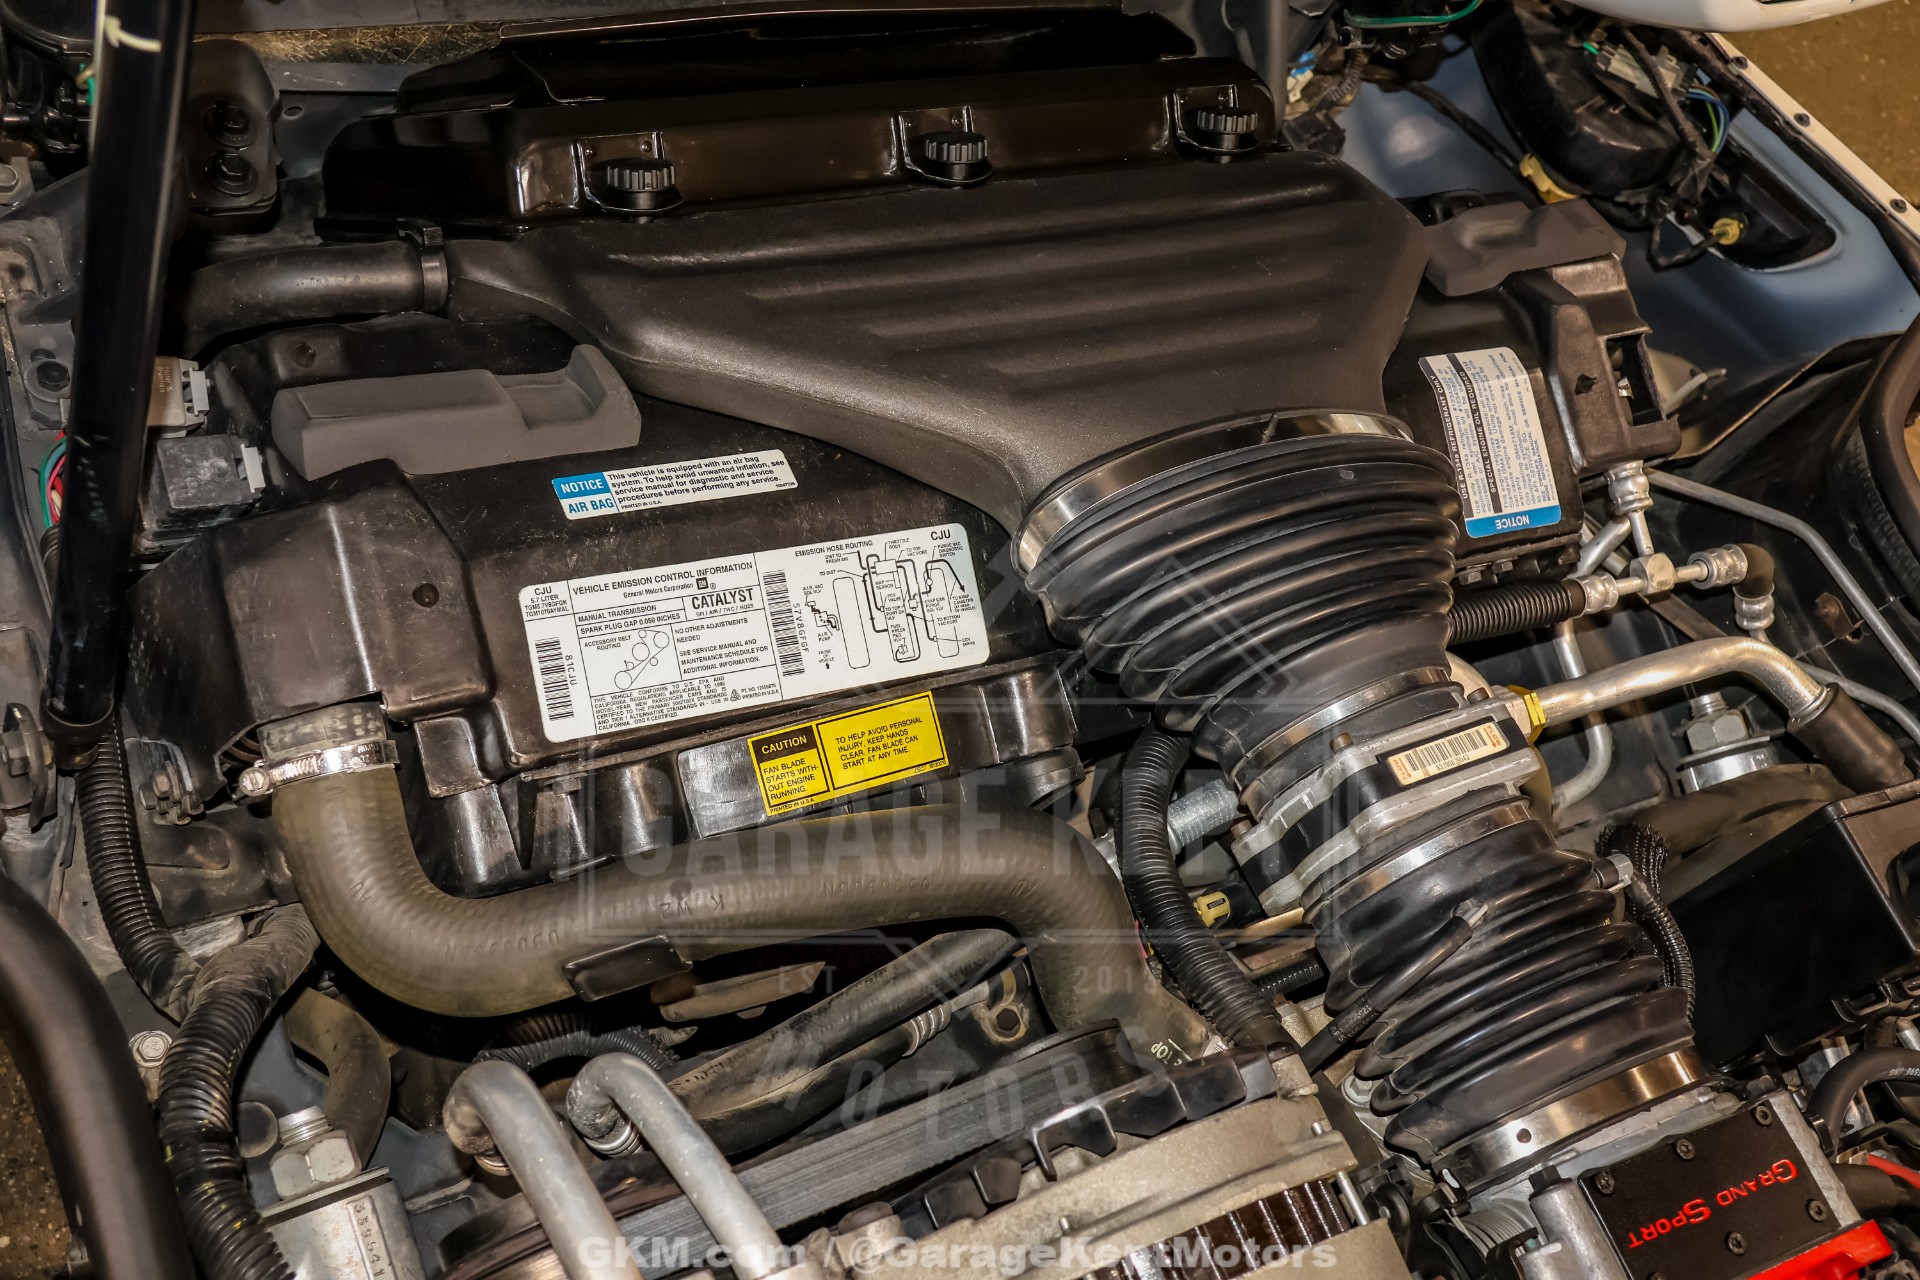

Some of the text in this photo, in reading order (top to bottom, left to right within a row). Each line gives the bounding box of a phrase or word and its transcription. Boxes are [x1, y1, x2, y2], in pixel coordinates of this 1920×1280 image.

[1430, 376, 1443, 393] ONLY
[1459, 371, 1477, 409] REQUIRED
[1441, 394, 1458, 451] REFRIGERANT
[1455, 416, 1467, 449] refrigerant
[1478, 426, 1489, 457] ENGINE
[607, 472, 626, 480] This
[626, 468, 656, 478] vehicle
[665, 462, 703, 474] equipped
[702, 460, 720, 468] with
[743, 455, 759, 463] bag
[1456, 453, 1466, 480] R-134a
[1463, 453, 1472, 478] R-134a
[610, 478, 643, 488] system.
[655, 473, 674, 482] help
[674, 471, 696, 479] avoid
[697, 465, 735, 476] unwanted
[613, 485, 644, 495] service
[644, 481, 674, 490] manual
[687, 474, 729, 486] diagnostic
[729, 471, 745, 479] and
[745, 468, 774, 477] service
[1485, 459, 1497, 492] SPECIAL
[560, 478, 604, 493] NOTICE
[617, 490, 664, 504] procedures
[663, 486, 690, 496] before
[691, 481, 734, 493] performing
[735, 479, 750, 487] any
[750, 475, 781, 484] service.
[567, 497, 614, 513] AIR BAG
[1495, 515, 1529, 529] NOTICE
[929, 529, 950, 541] CJU
[794, 539, 873, 557] EMISSION HOSE ROUTING
[572, 561, 752, 595] VEHICLE EMISSION CONTROL INFORMATION
[533, 585, 552, 596] CJU
[540, 594, 559, 602] LITER
[623, 589, 644, 598] General
[644, 586, 663, 595] Motors
[663, 581, 693, 592] Corporation
[690, 587, 754, 610] CATALYST
[577, 604, 656, 623] MANUAL TRANSMISSION
[579, 625, 603, 635] SPARK
[604, 621, 625, 631] PLUG
[625, 619, 638, 627] GAP
[656, 612, 680, 622] INCHES
[684, 624, 705, 633] OTHER
[705, 617, 748, 629] ADJUSTMENTS
[584, 637, 617, 647] ACCESSORY
[596, 642, 621, 651] ROUTING
[676, 634, 700, 643] NEEDED
[678, 649, 691, 657] SEE
[692, 644, 717, 654] SERVICE
[718, 640, 743, 650] MANUAL
[680, 653, 723, 666] MAINTENANCE
[724, 647, 755, 658] SCHEDULE
[564, 654, 577, 685] 81CJU
[682, 663, 718, 674] ADDITIONAL
[835, 716, 922, 744] TO HELP AVOID PERSONAL
[866, 734, 884, 745] KEEP
[886, 728, 908, 740] HANDS
[1487, 725, 1502, 746] FLOW
[761, 734, 807, 754] CAUTION
[867, 744, 881, 754] FAN
[882, 738, 903, 750] BLADE
[904, 734, 918, 744] CAN
[763, 757, 806, 775] FAN BLADE
[842, 745, 910, 769] START AT ANY TIME.
[765, 763, 819, 784] STARTS WITH-
[1392, 759, 1407, 780] FLOW
[767, 773, 815, 792] OUT ENGINE
[770, 784, 807, 801] RUNNING.
[769, 803, 792, 813] PRINTED
